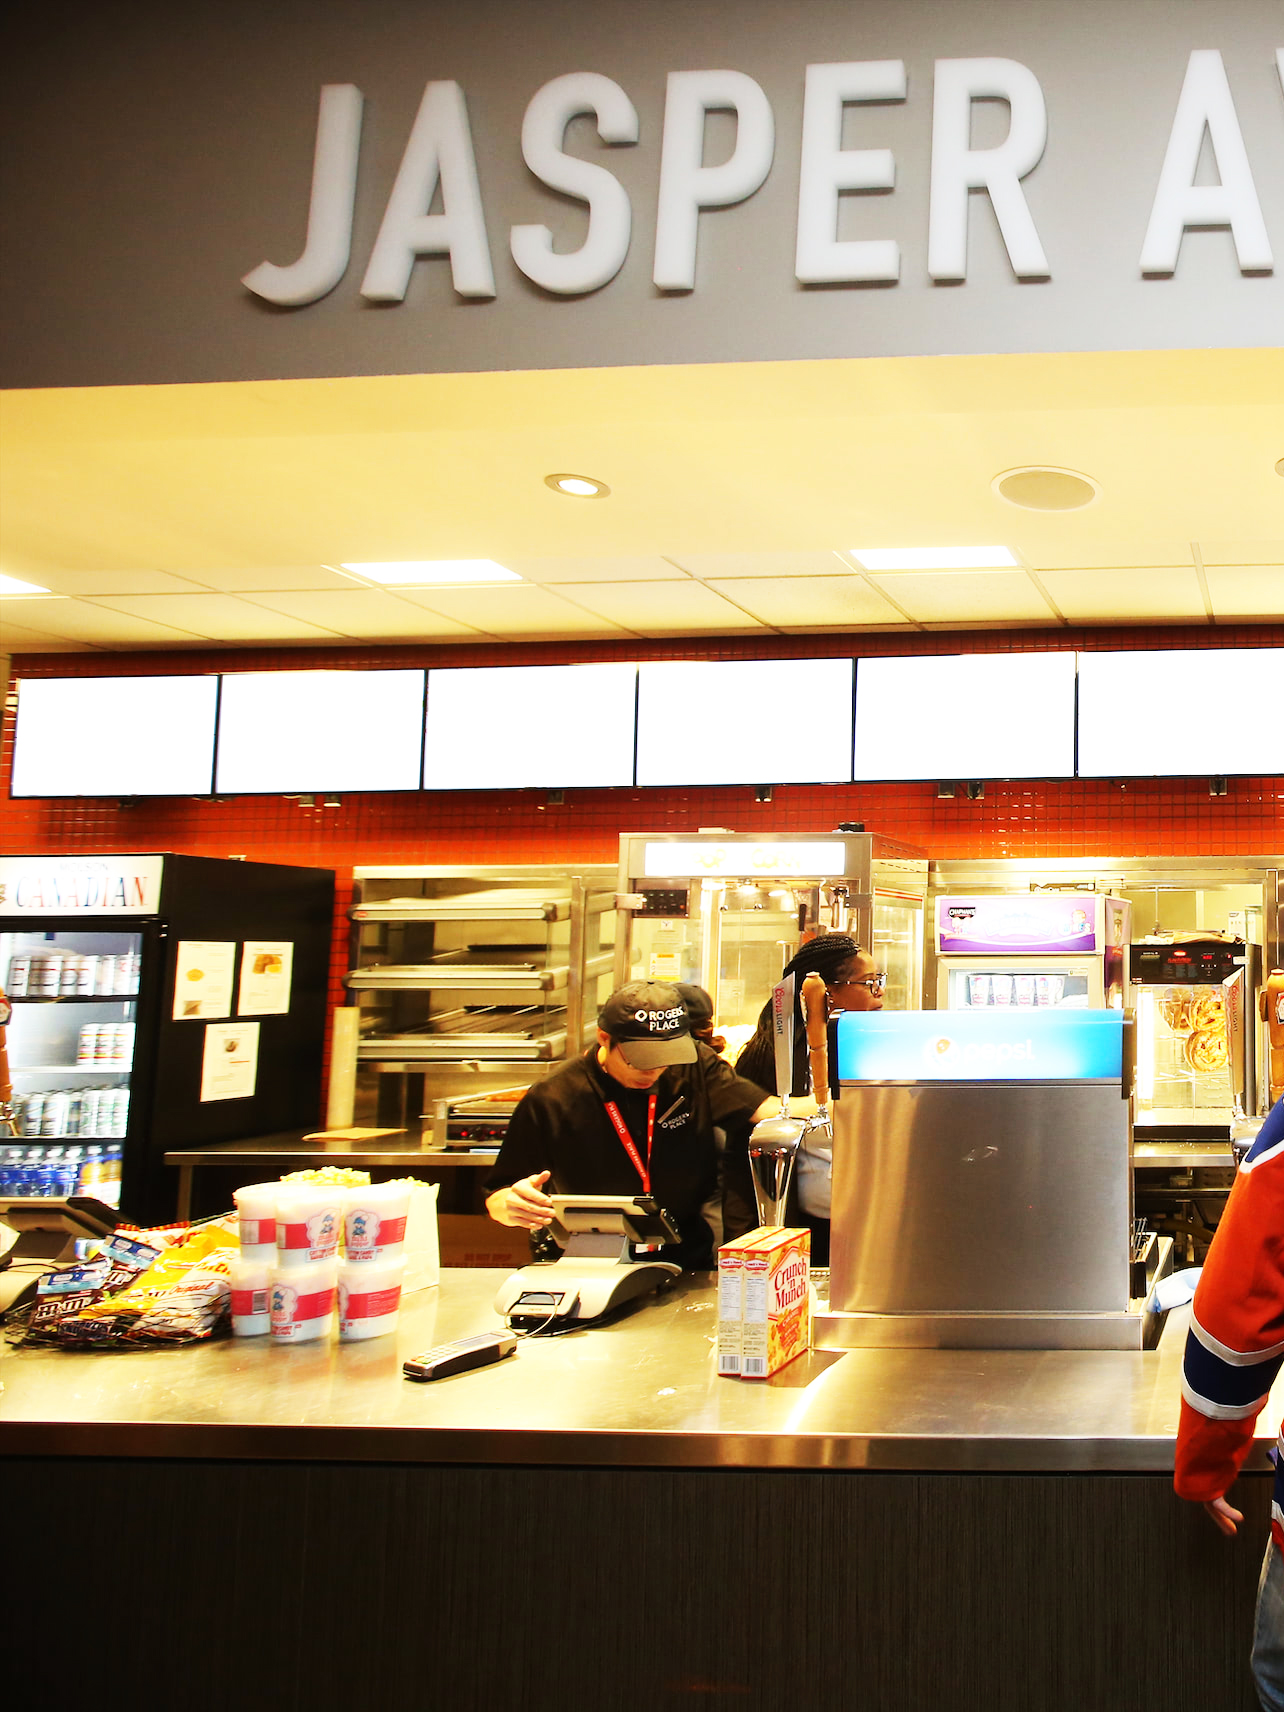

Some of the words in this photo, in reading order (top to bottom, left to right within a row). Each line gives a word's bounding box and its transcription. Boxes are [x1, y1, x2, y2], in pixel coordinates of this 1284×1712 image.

[240, 57, 1052, 306] JASPER
[15, 876, 149, 908] CANADIAN
[648, 1006, 684, 1021] ROGERS
[649, 1018, 680, 1031] PLACE
[963, 1039, 1036, 1066] pepsi
[169, 1281, 215, 1296] Original
[775, 1257, 807, 1291] Crunch
[775, 1278, 807, 1312] Munch
